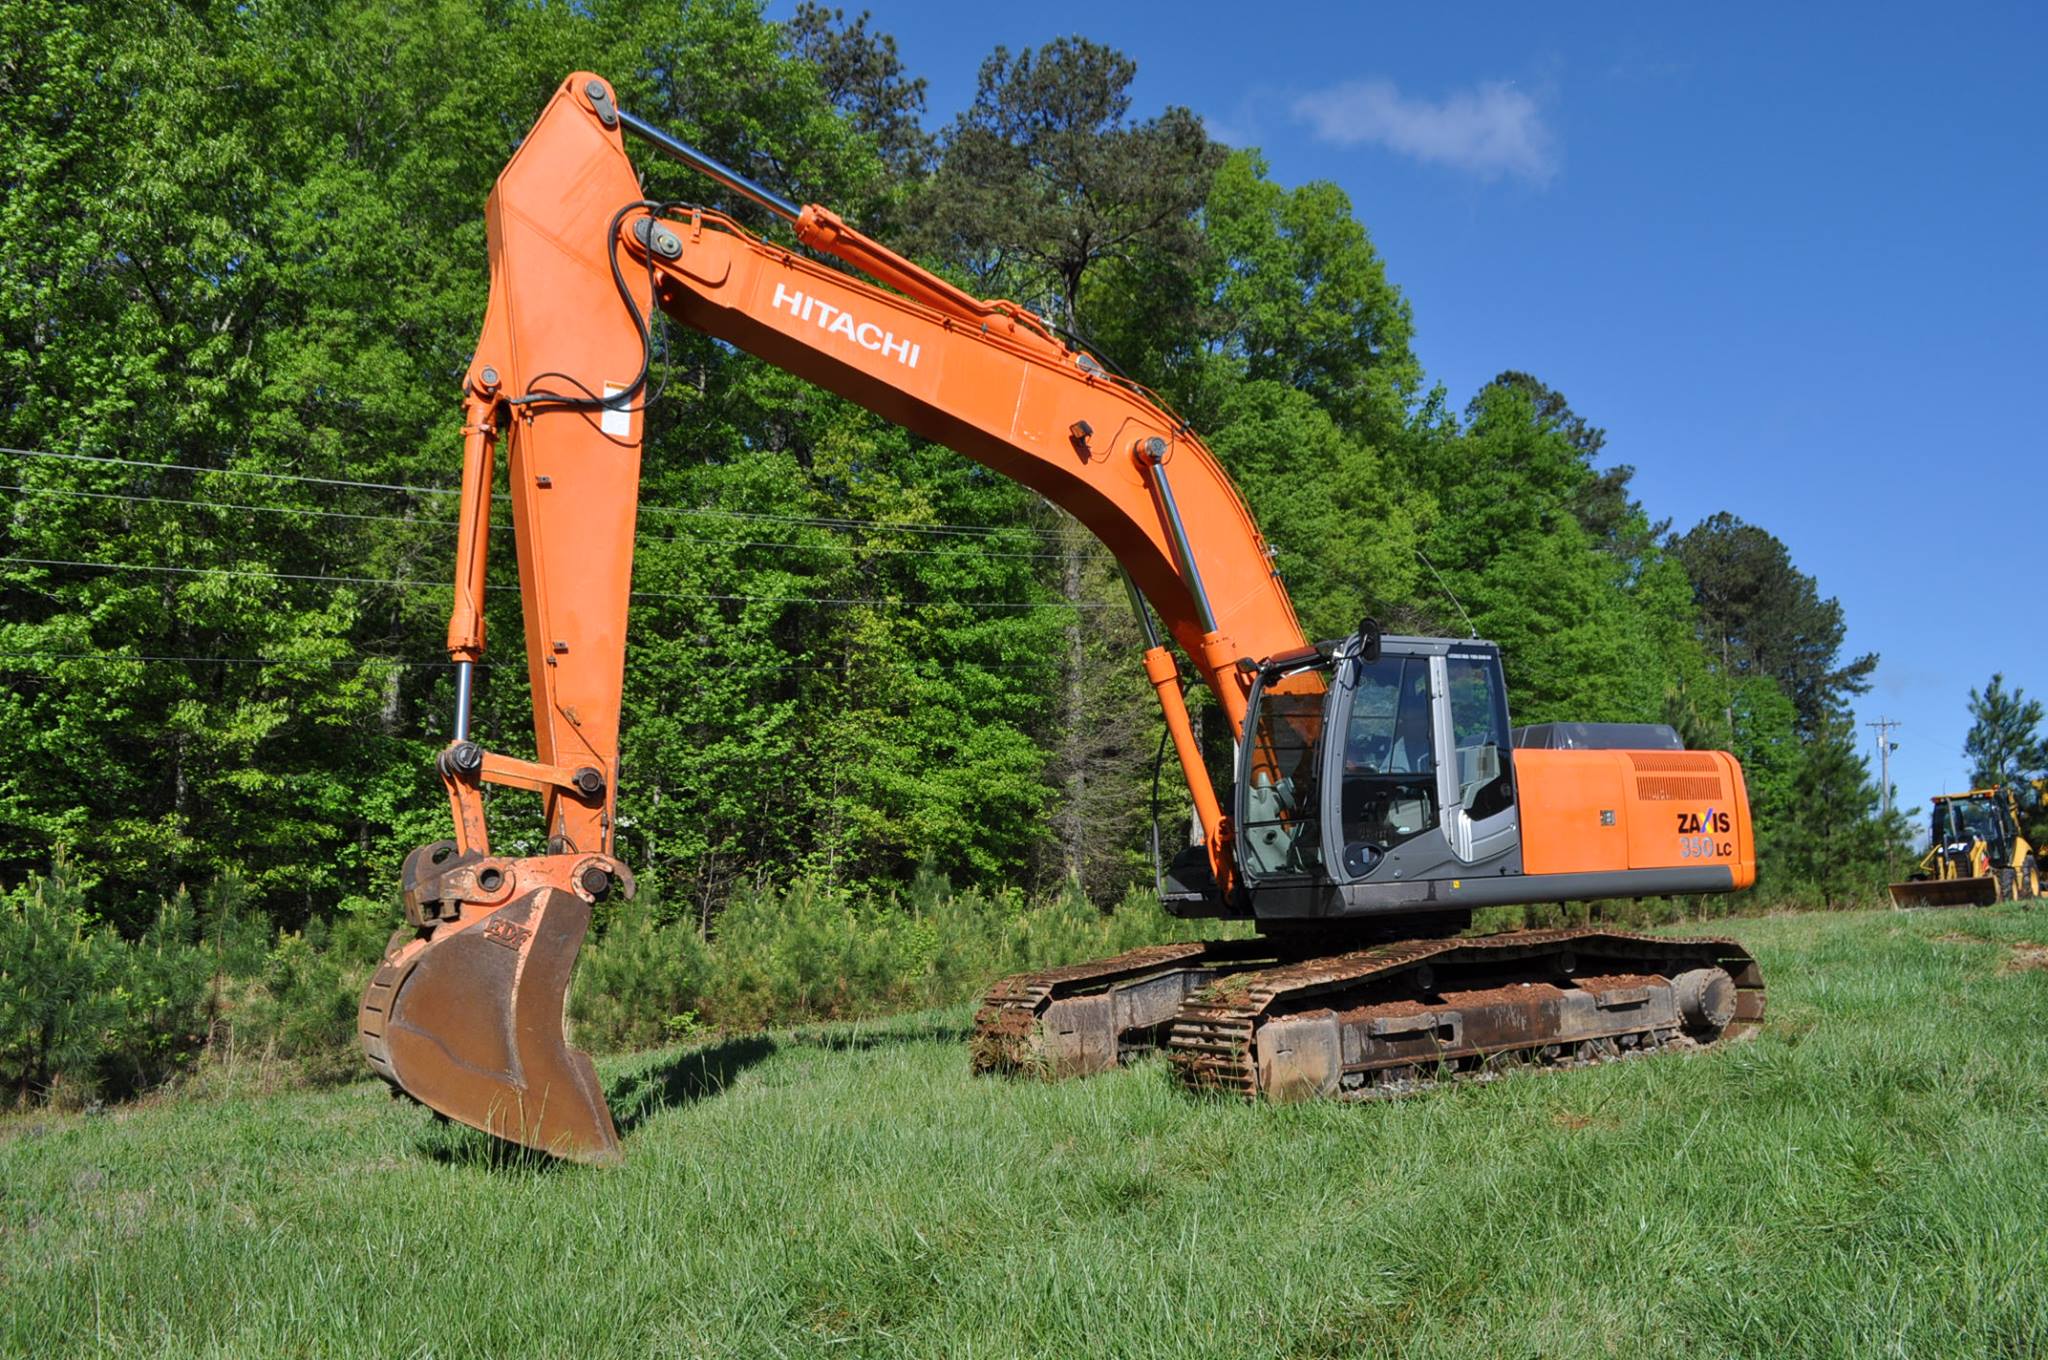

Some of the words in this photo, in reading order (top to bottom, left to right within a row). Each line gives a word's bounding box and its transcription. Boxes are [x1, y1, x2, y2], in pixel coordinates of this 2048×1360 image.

[772, 283, 920, 369] HITACHI
[1677, 807, 1730, 834] ZAXIS
[1680, 836, 1713, 858] 350
[1716, 842, 1732, 857] LC
